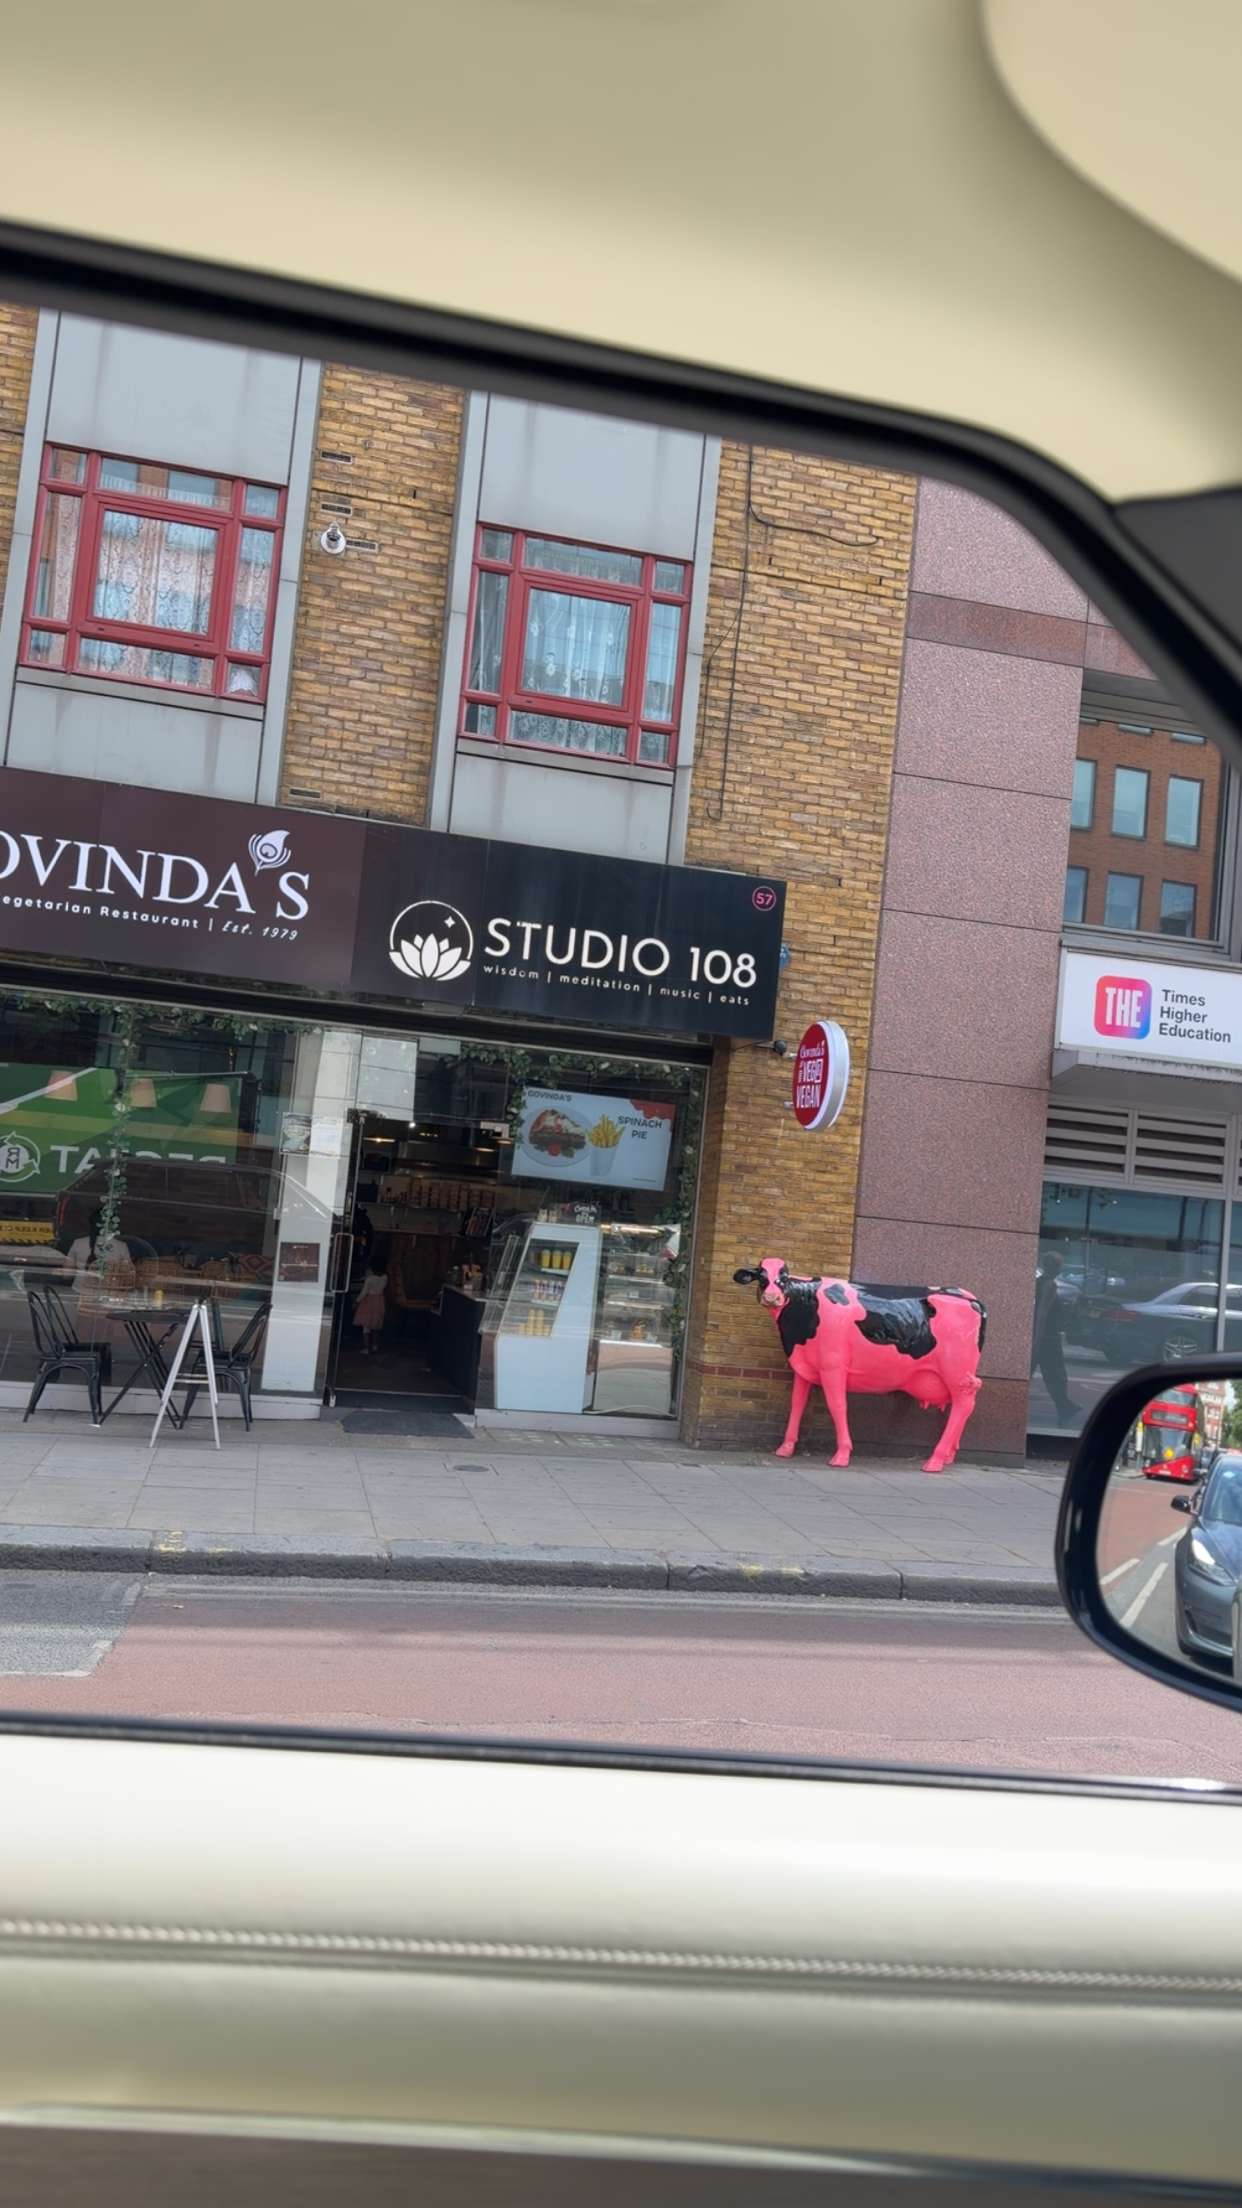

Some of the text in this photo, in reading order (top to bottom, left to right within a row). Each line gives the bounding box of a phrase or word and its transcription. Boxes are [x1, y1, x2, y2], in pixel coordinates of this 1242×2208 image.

[756, 892, 773, 905] 57
[100, 905, 198, 928] Restaurant
[222, 921, 253, 935] Est.
[262, 926, 298, 940] 1979
[484, 917, 757, 988] STUDIO 108
[483, 964, 539, 979] wisdom
[559, 974, 640, 992] meditation
[660, 987, 700, 1000] music
[720, 995, 749, 1006] eats
[1105, 987, 1143, 1028] THE
[1162, 989, 1206, 1007] Times
[1160, 1006, 1207, 1024] Higher
[1158, 1022, 1231, 1043] Education
[617, 1115, 662, 1129] SPINACH
[632, 1130, 648, 1140] PIE
